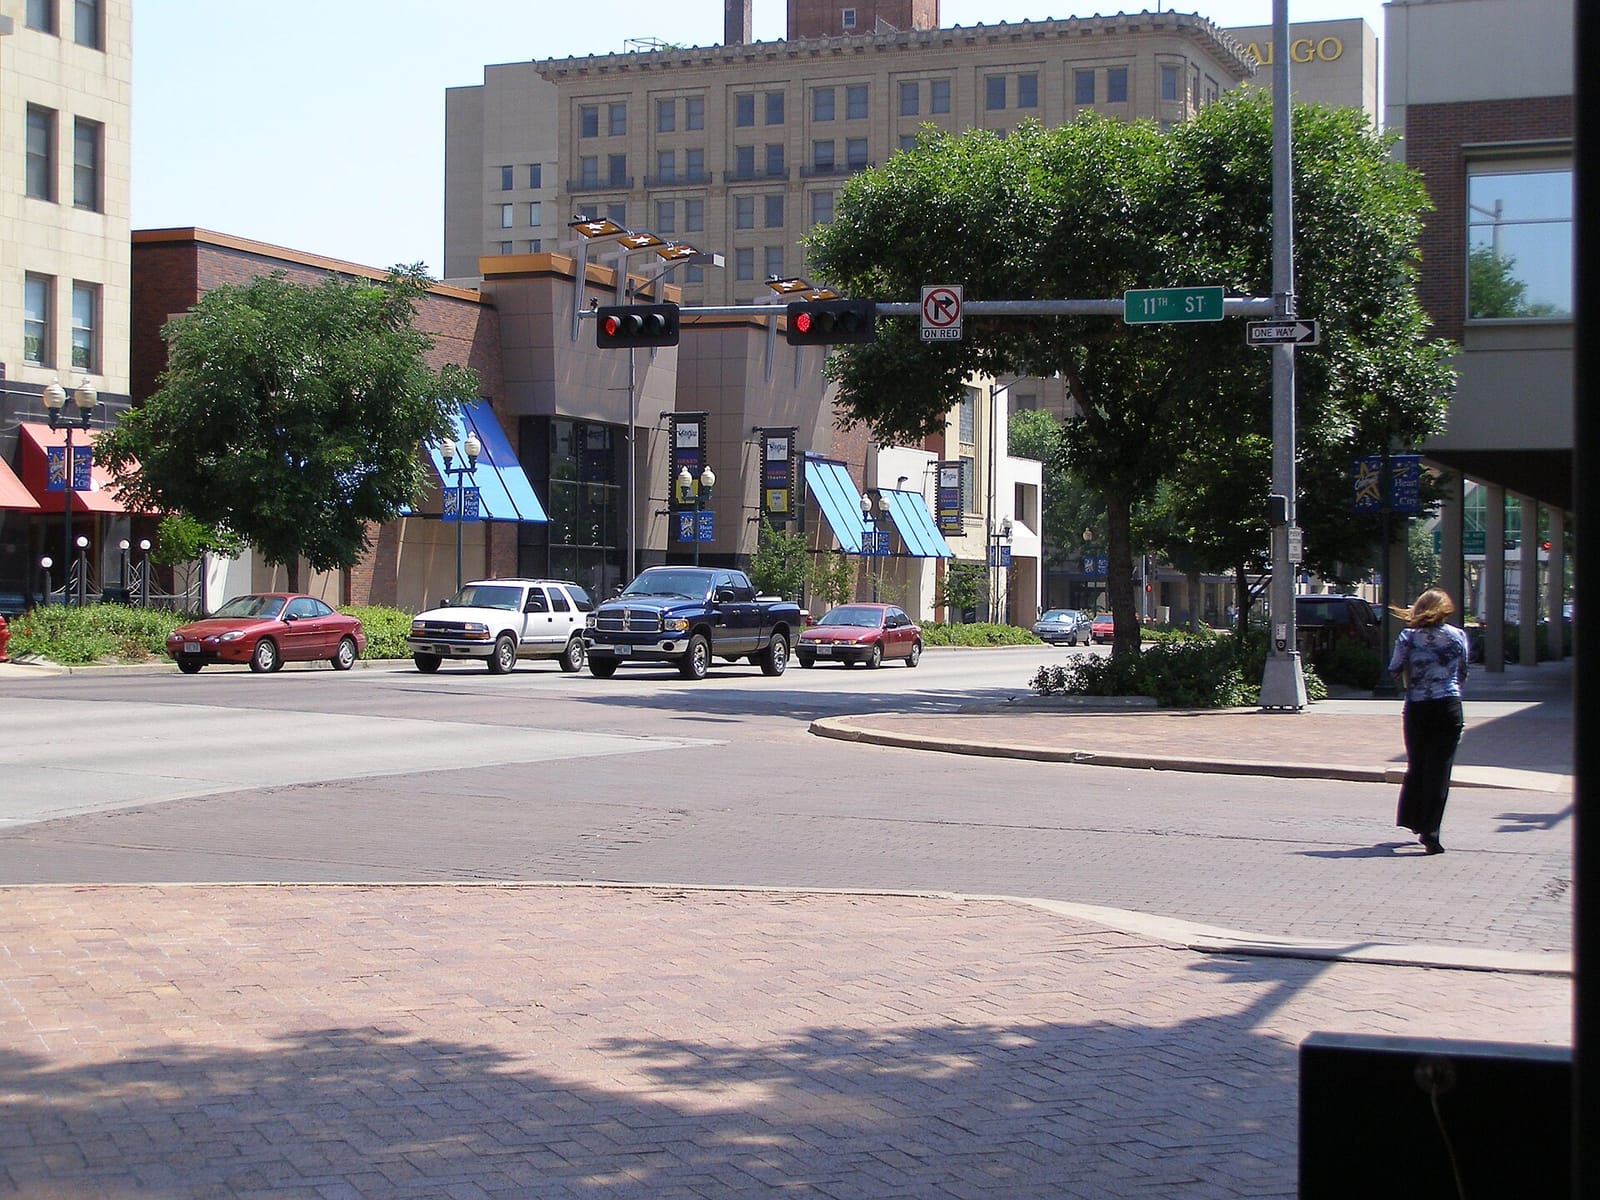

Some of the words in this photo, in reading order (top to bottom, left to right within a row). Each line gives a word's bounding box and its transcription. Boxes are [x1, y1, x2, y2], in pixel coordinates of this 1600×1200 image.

[1143, 297, 1168, 314] 11TH
[1185, 296, 1204, 312] ST
[924, 330, 937, 338] ON
[940, 330, 958, 338] RED
[1254, 328, 1272, 337] ONE
[1276, 327, 1295, 336] WAY
